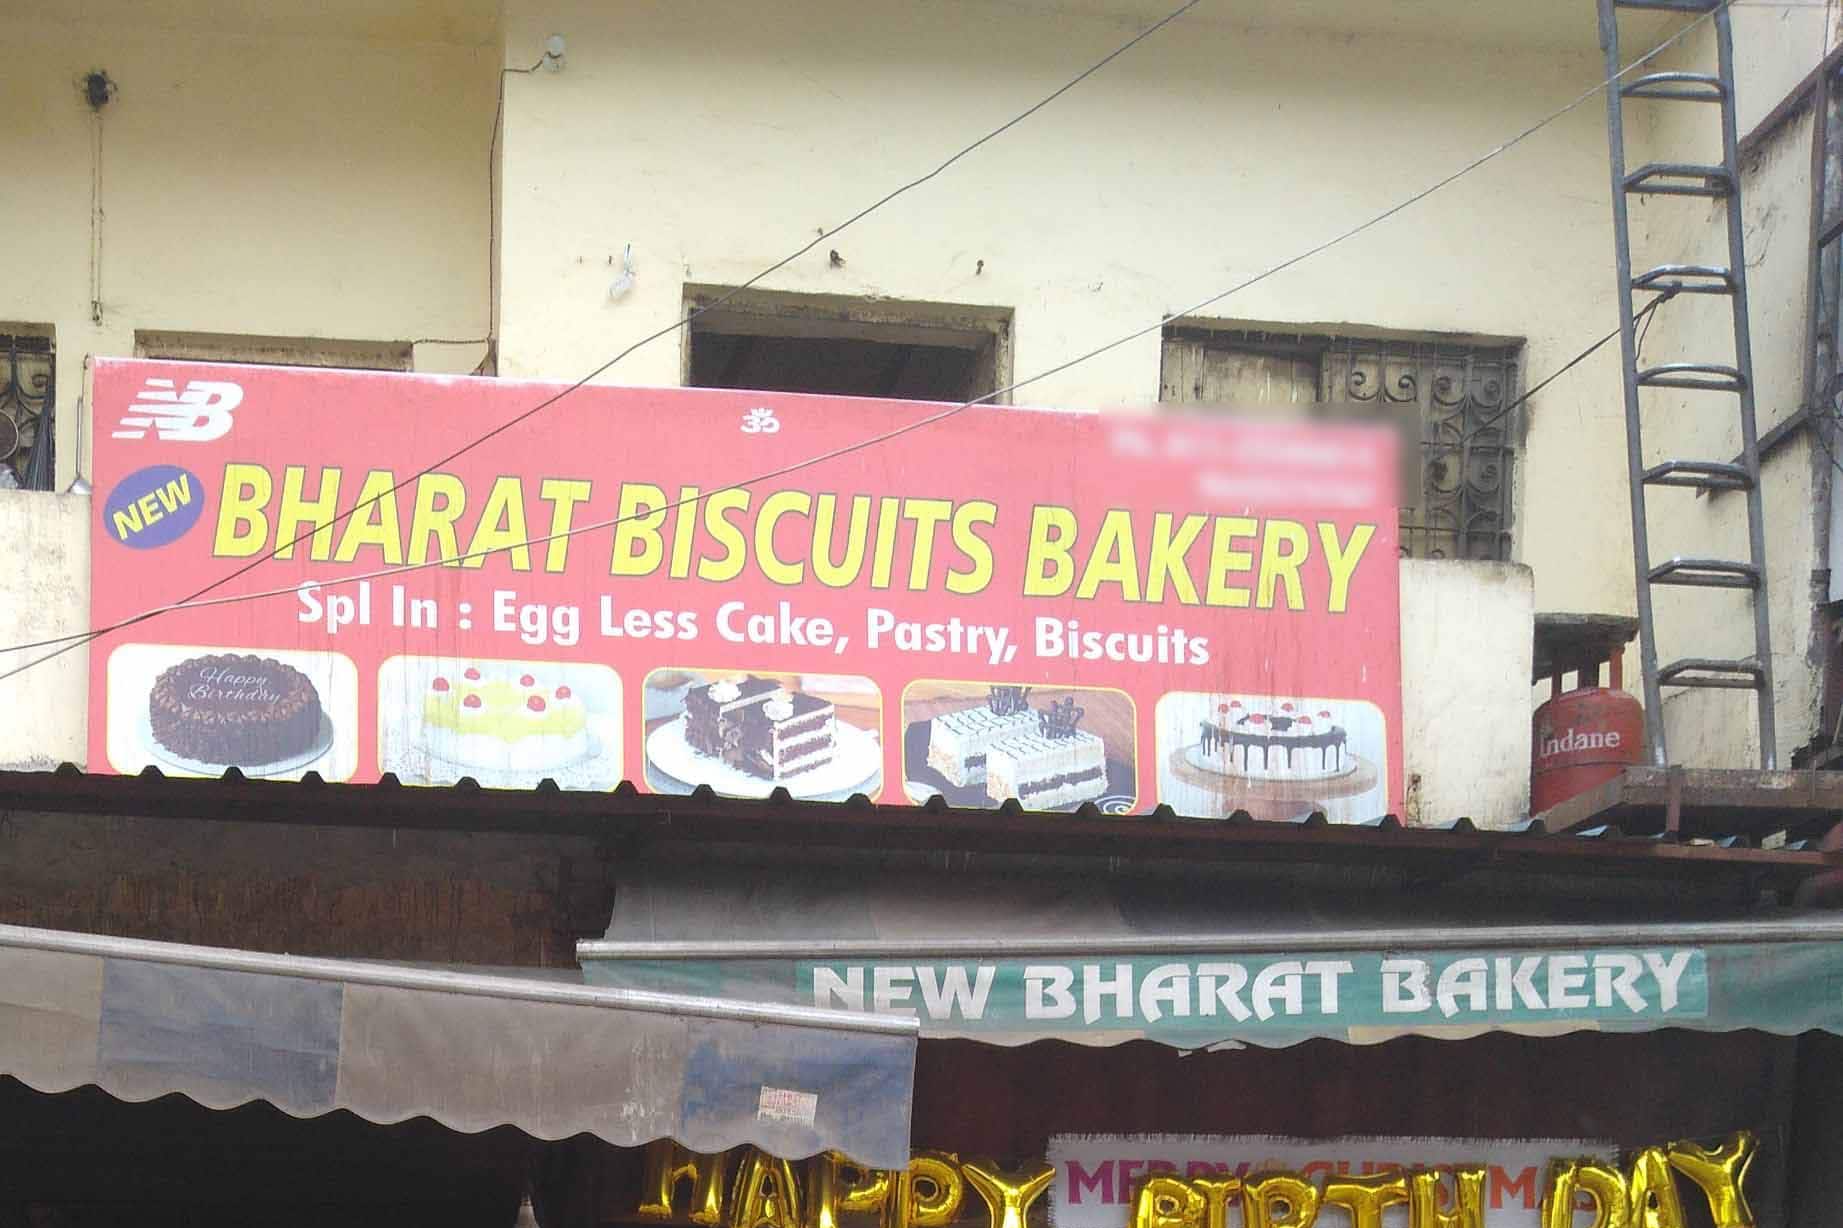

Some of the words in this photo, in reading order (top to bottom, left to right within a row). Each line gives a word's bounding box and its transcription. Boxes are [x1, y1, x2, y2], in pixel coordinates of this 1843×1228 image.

[112, 474, 194, 542] NEW
[213, 463, 592, 574] BHARAT
[609, 482, 998, 595] BISCUITS
[1023, 504, 1378, 614] BAKERY
[297, 580, 371, 634] Spl
[392, 585, 438, 629] In
[493, 590, 580, 645] Egg
[600, 595, 698, 641] Less
[716, 601, 849, 656] Cake,
[867, 607, 1018, 664] Pastry,
[1034, 616, 1210, 665] Biscuits
[189, 684, 281, 704] Birthday
[200, 667, 267, 688] Happy
[813, 964, 996, 1020] NEW
[1024, 958, 1354, 1025] BHARAT
[1381, 950, 1697, 1019] BAKERY
